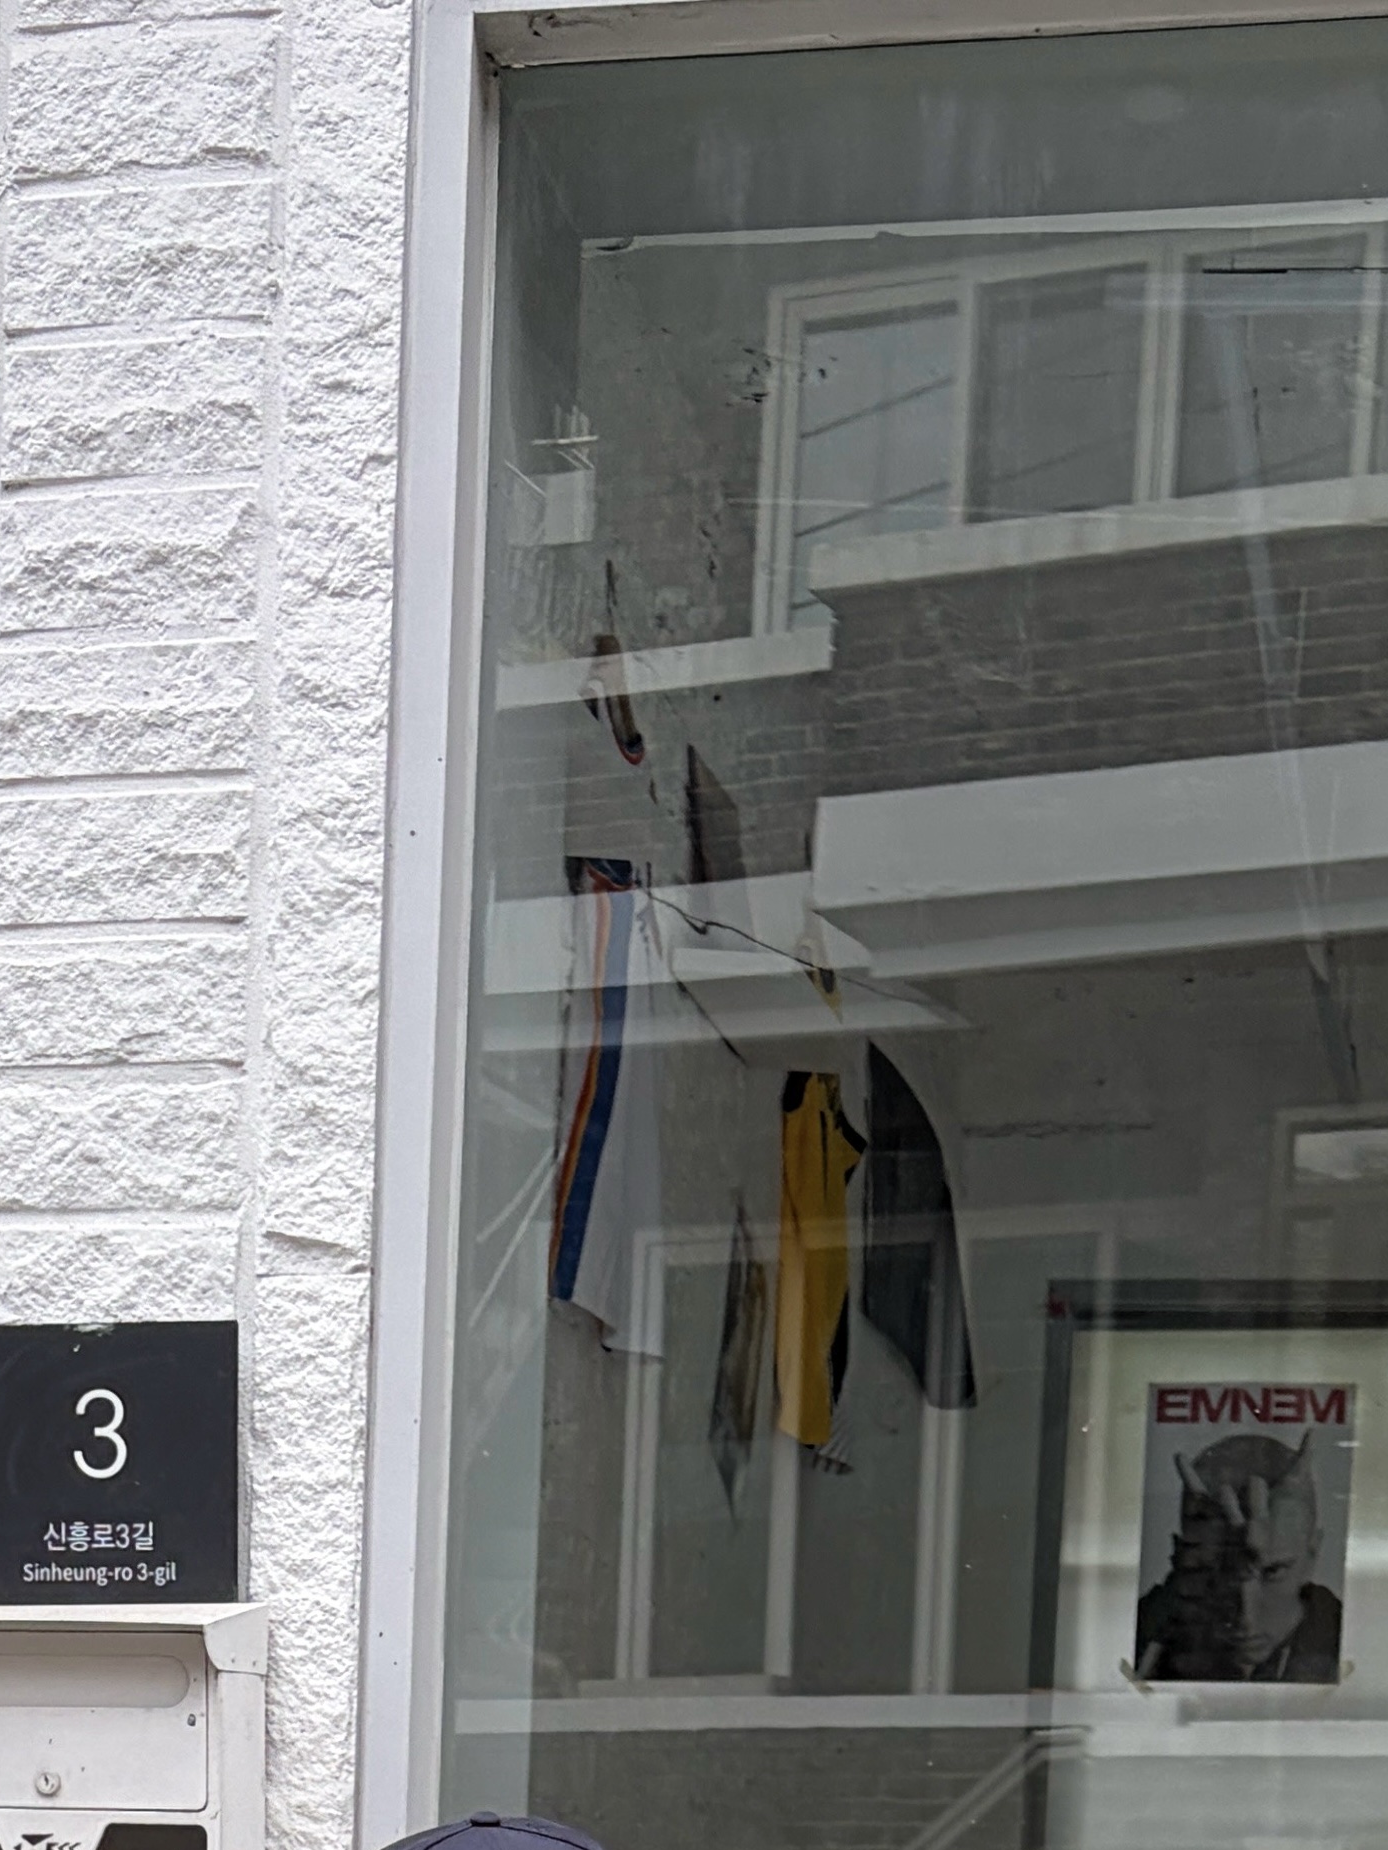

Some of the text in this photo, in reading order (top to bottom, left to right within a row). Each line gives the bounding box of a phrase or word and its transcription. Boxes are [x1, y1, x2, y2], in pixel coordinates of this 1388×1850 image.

[73, 1388, 128, 1480] 3
[43, 1520, 154, 1552] 신흥로3길
[23, 1561, 177, 1587] Sinheung-ro 3-gil
